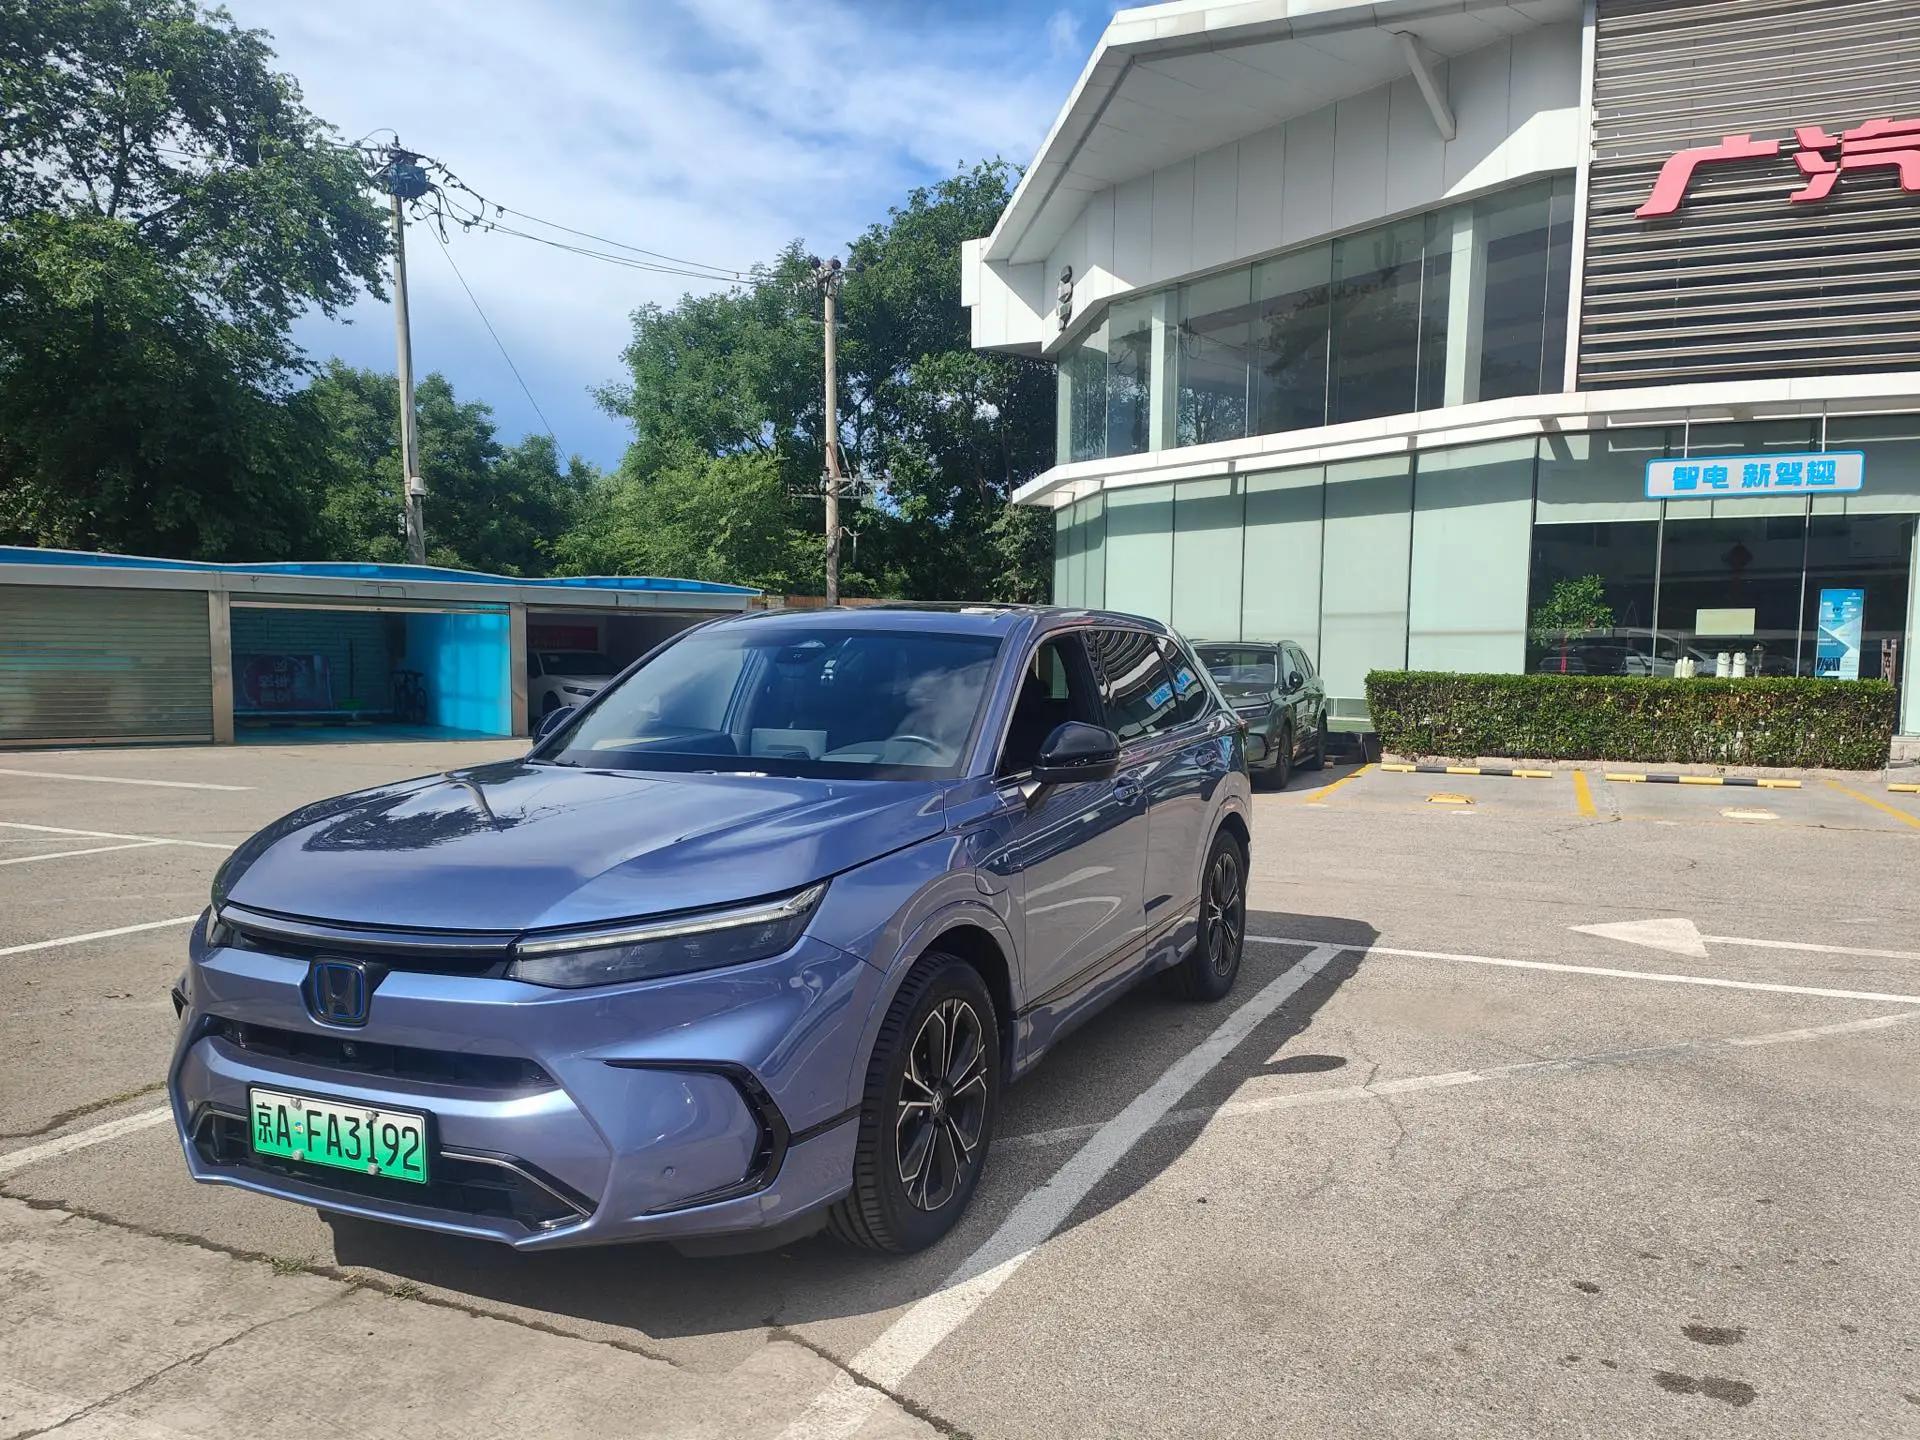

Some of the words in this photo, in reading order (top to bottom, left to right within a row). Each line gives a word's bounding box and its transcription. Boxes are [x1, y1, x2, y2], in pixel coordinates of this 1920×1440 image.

[1673, 465, 1730, 491] 智电
[1741, 460, 1836, 489] 新驾趣
